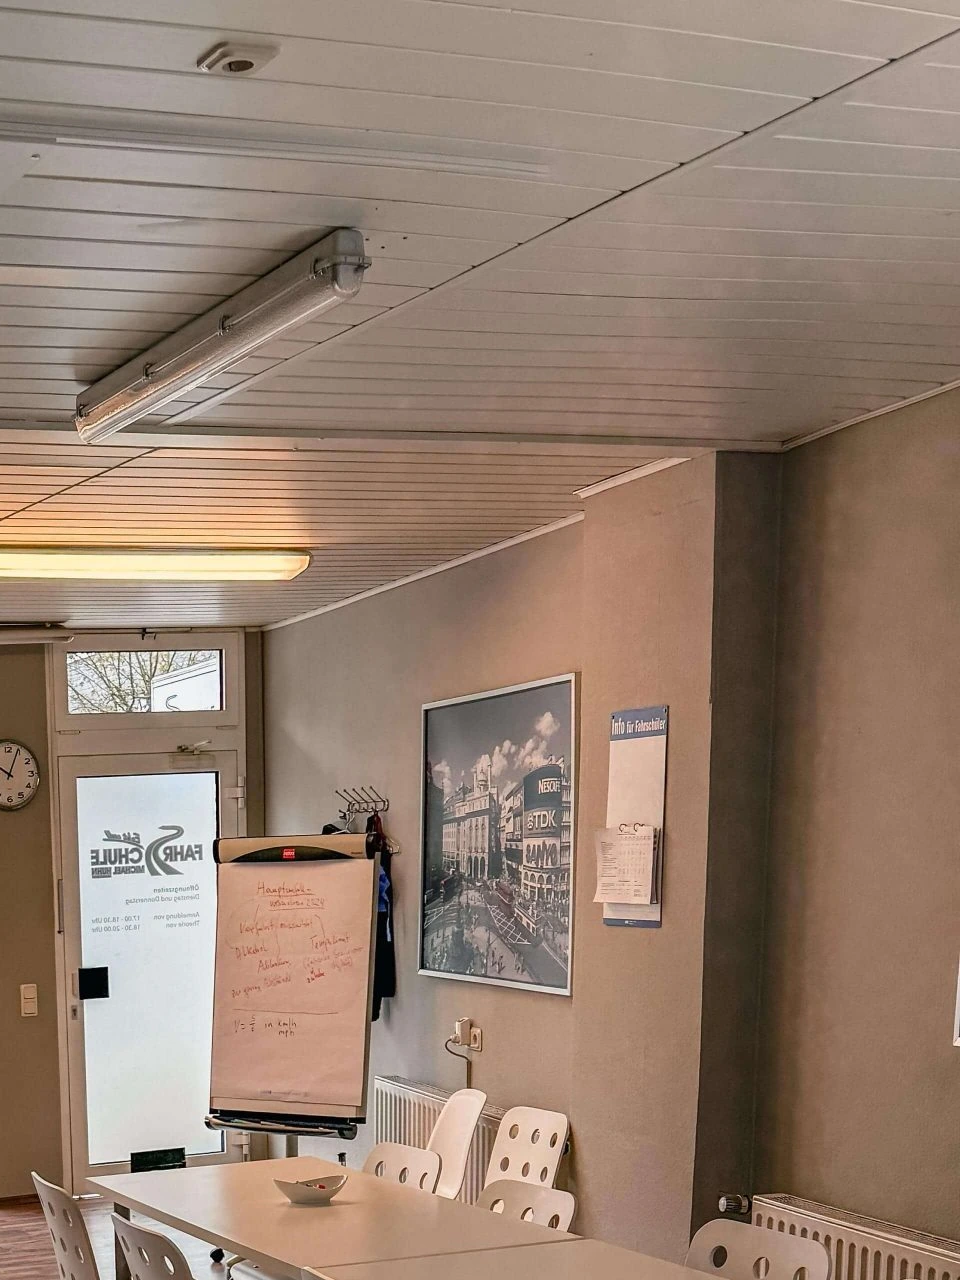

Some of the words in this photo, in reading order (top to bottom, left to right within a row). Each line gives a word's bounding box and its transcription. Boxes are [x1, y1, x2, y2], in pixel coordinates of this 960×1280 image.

[611, 717, 625, 736] Info
[626, 720, 635, 734] für
[635, 717, 666, 733] Fahrschüler
[4, 746, 13, 754] 12
[533, 810, 557, 829] TDK
[525, 840, 558, 868] SANYO
